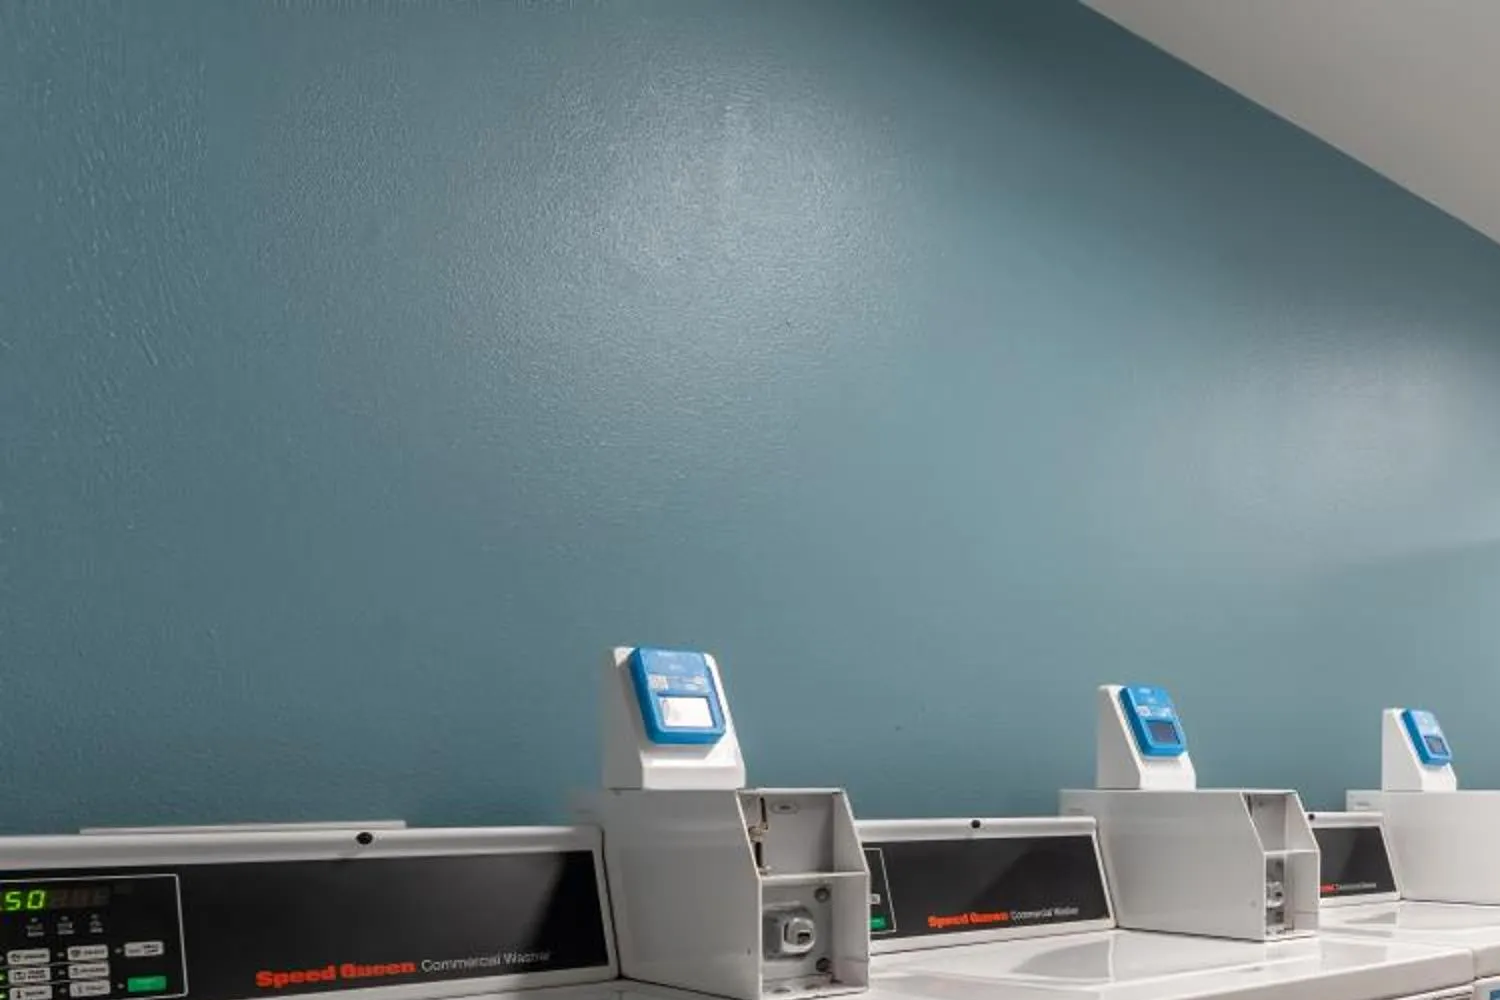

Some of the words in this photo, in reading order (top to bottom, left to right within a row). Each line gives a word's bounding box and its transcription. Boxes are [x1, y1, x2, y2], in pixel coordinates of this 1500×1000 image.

[255, 964, 336, 988] Speed
[340, 961, 417, 979] Queen
[421, 953, 500, 973] Commercial
